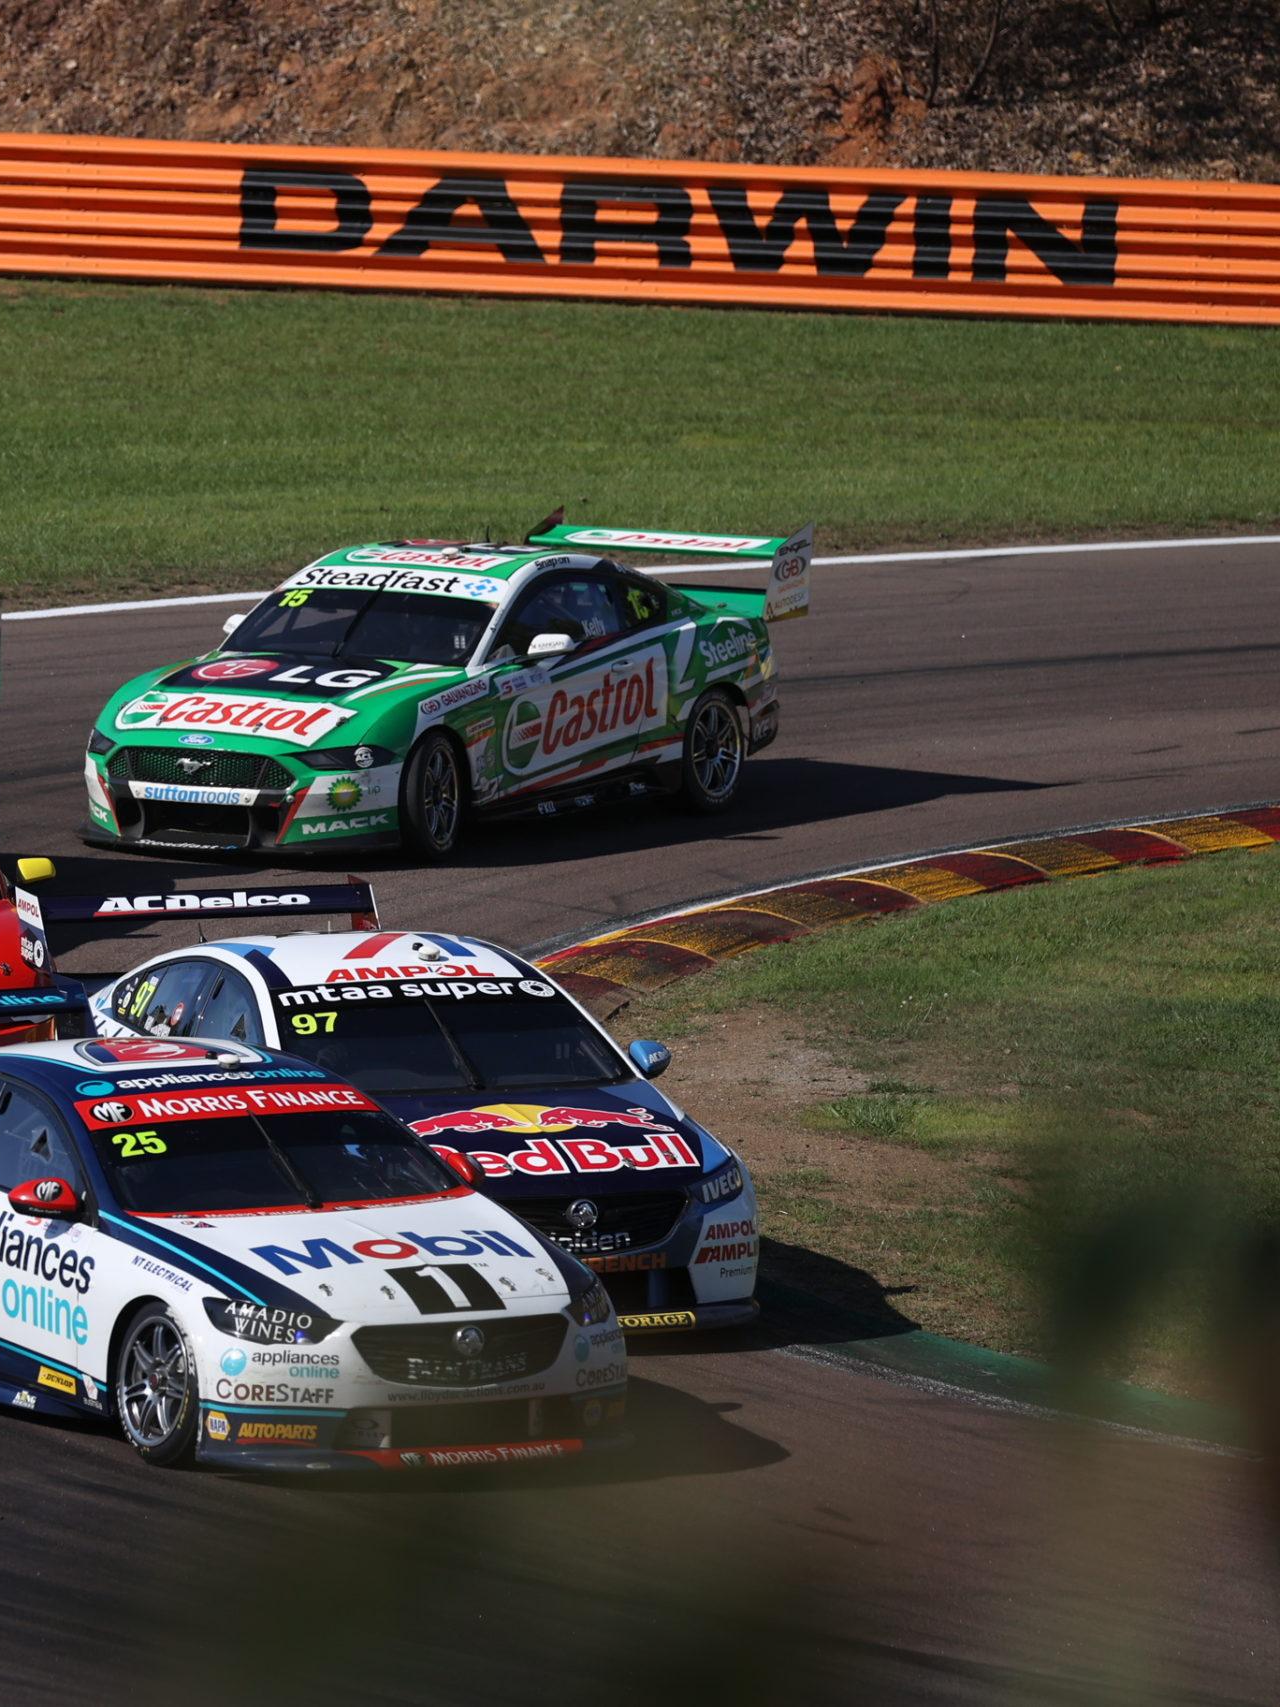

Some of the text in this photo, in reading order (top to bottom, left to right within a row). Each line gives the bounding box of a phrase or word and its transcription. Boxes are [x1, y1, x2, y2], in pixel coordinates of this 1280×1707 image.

[239, 168, 1119, 287] DARWIN
[381, 551, 494, 568] Castrol
[296, 568, 460, 594] Steadfast
[278, 589, 314, 608] 15
[581, 617, 606, 637] Kelly
[699, 627, 756, 668] Steeline
[268, 665, 382, 688] LG
[163, 696, 332, 737] Castrol
[542, 656, 658, 756] Castrol
[144, 785, 240, 805] suttontools
[302, 813, 390, 835] MACK
[134, 838, 219, 850] Steadfast
[98, 892, 310, 913] ACDelco
[325, 964, 495, 983] AMPOL
[130, 980, 157, 1018] 97
[278, 980, 514, 1007] mtaa super
[291, 1012, 338, 1035] 97
[92, 1090, 364, 1123] MF MORRIS FINANCE
[112, 1130, 167, 1158] 25
[429, 1133, 700, 1177] ed Bull
[36, 1181, 61, 1202] MF
[701, 1167, 741, 1203] IVECO
[705, 1220, 756, 1240] AMPOL
[249, 1230, 536, 1276] Mobil
[131, 1255, 194, 1293] NT ELECTRICAL
[415, 1266, 472, 1308] 1
[2, 1278, 88, 1346] online
[224, 1302, 313, 1329] AMADIO
[617, 1312, 689, 1328] TORAGE
[235, 1317, 296, 1344] WINES
[252, 1350, 340, 1366] appliances
[46, 1372, 74, 1389] DUNLOP
[289, 1366, 340, 1379] online
[210, 1418, 227, 1434] NAPA
[431, 1448, 497, 1467] MORRIS
[500, 1444, 564, 1460] FINANCE
